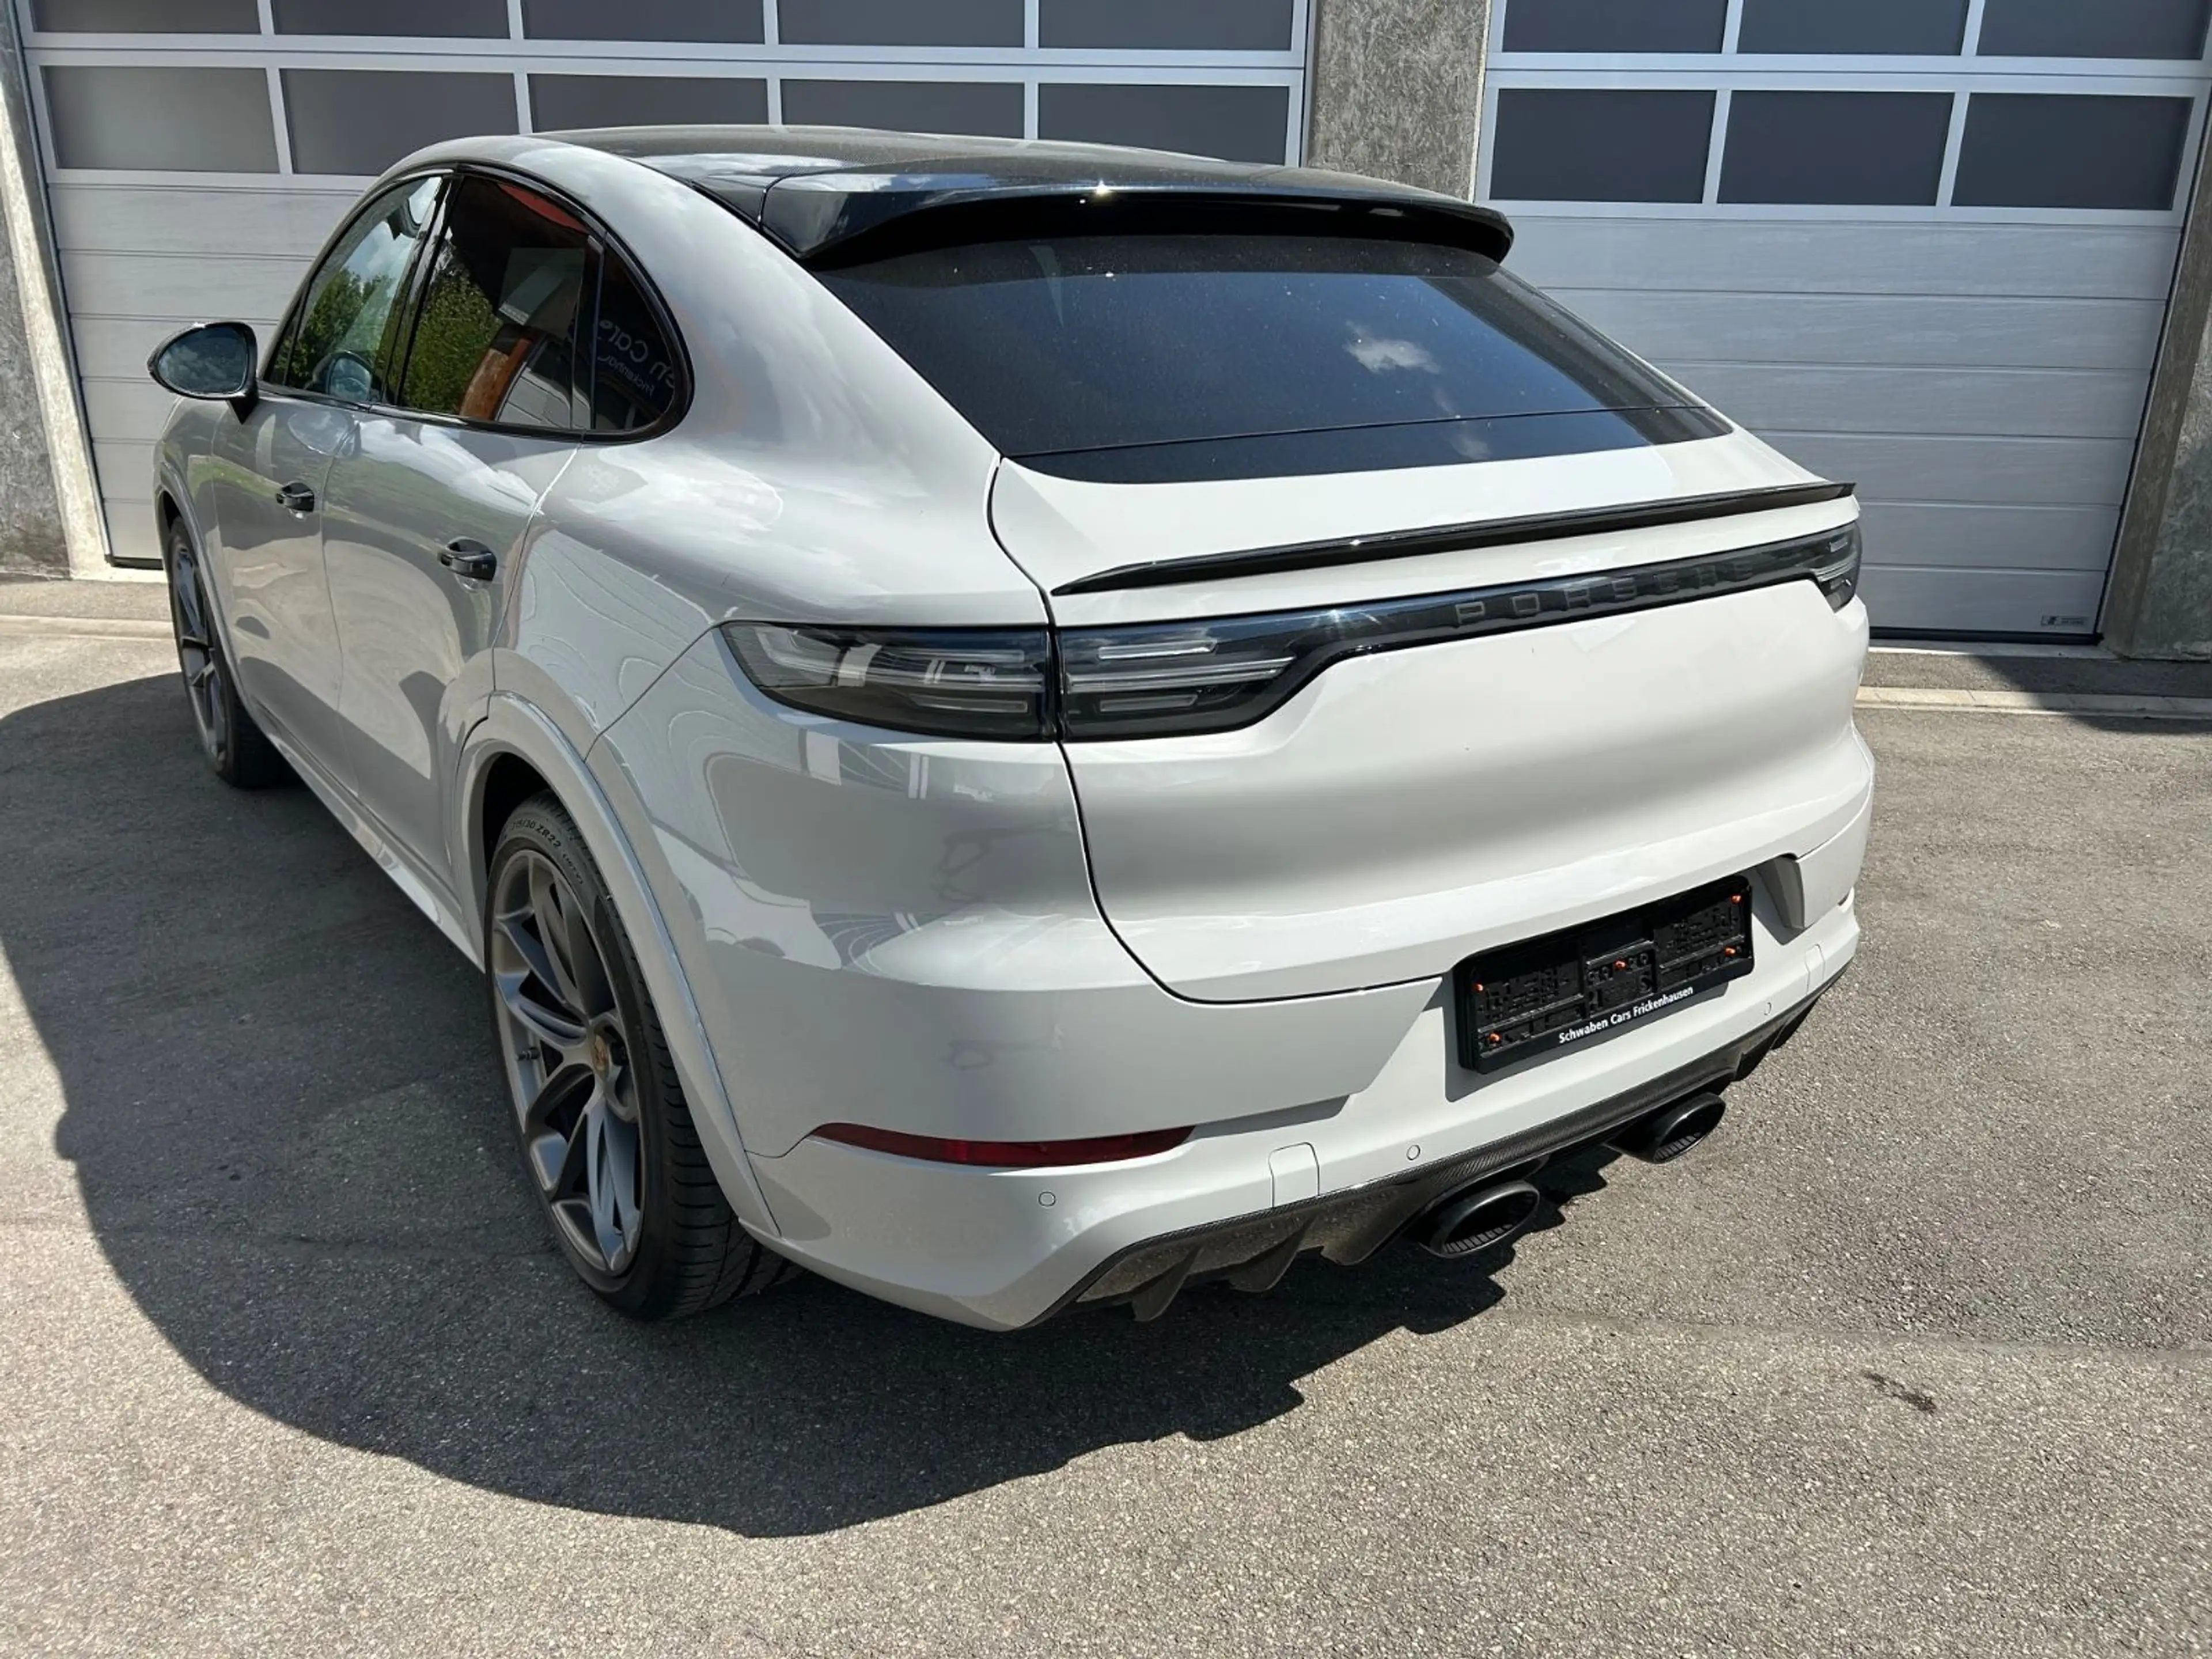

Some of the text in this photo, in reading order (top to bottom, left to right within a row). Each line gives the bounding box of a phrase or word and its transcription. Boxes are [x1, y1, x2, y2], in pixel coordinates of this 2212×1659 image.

[1455, 562, 1753, 624] PORSCHE
[1559, 986, 1694, 1043] Schwaben Cars Frickenhausen
